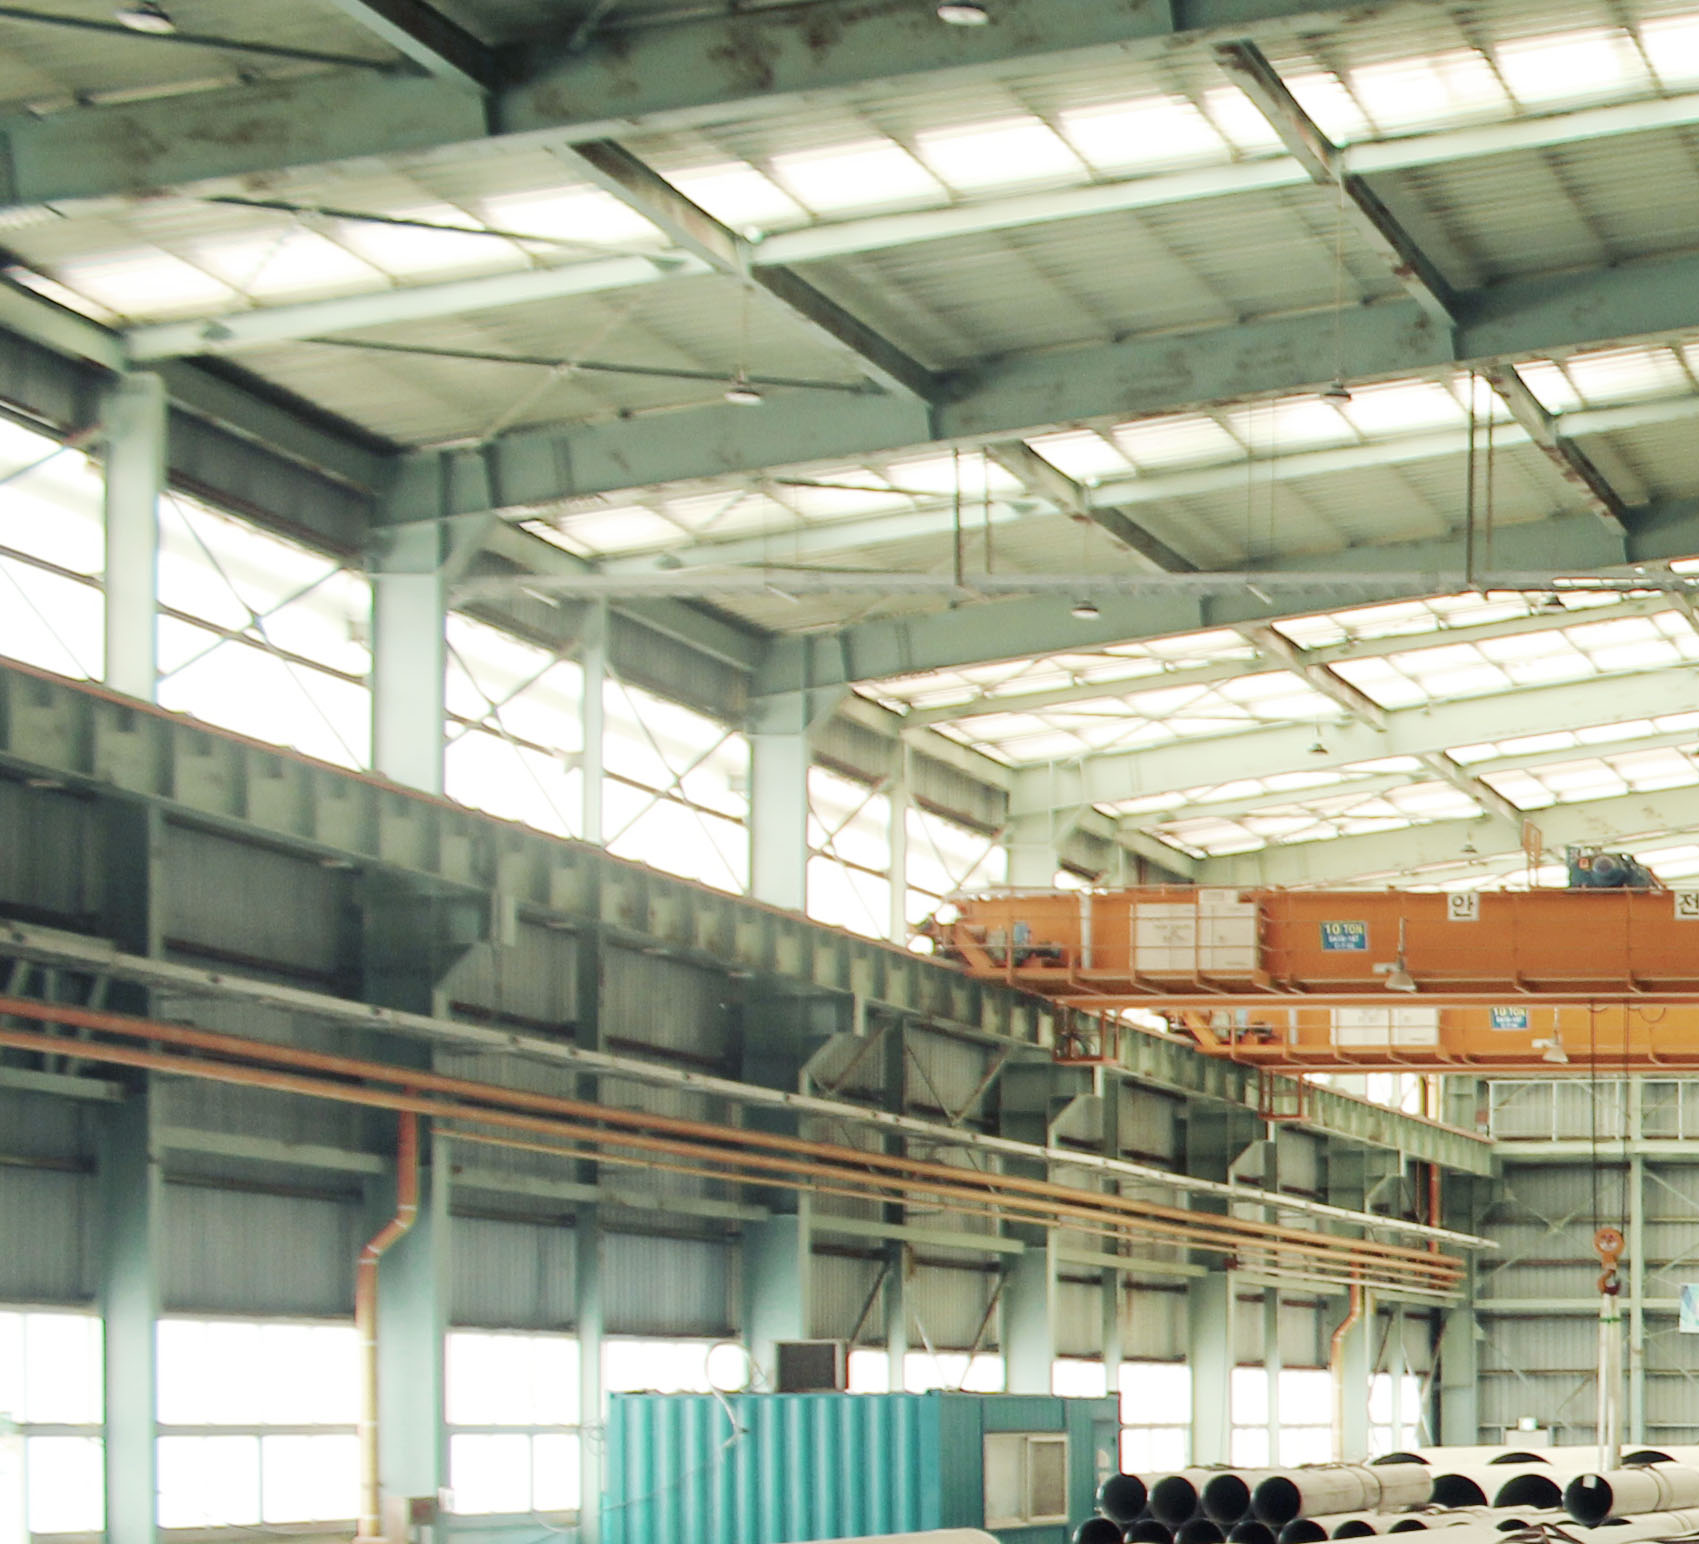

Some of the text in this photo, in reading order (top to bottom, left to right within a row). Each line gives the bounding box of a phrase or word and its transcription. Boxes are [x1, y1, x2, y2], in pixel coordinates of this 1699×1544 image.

[1452, 892, 1474, 917] 안
[1678, 893, 1699, 916] 전
[1326, 923, 1363, 935] 10 TON
